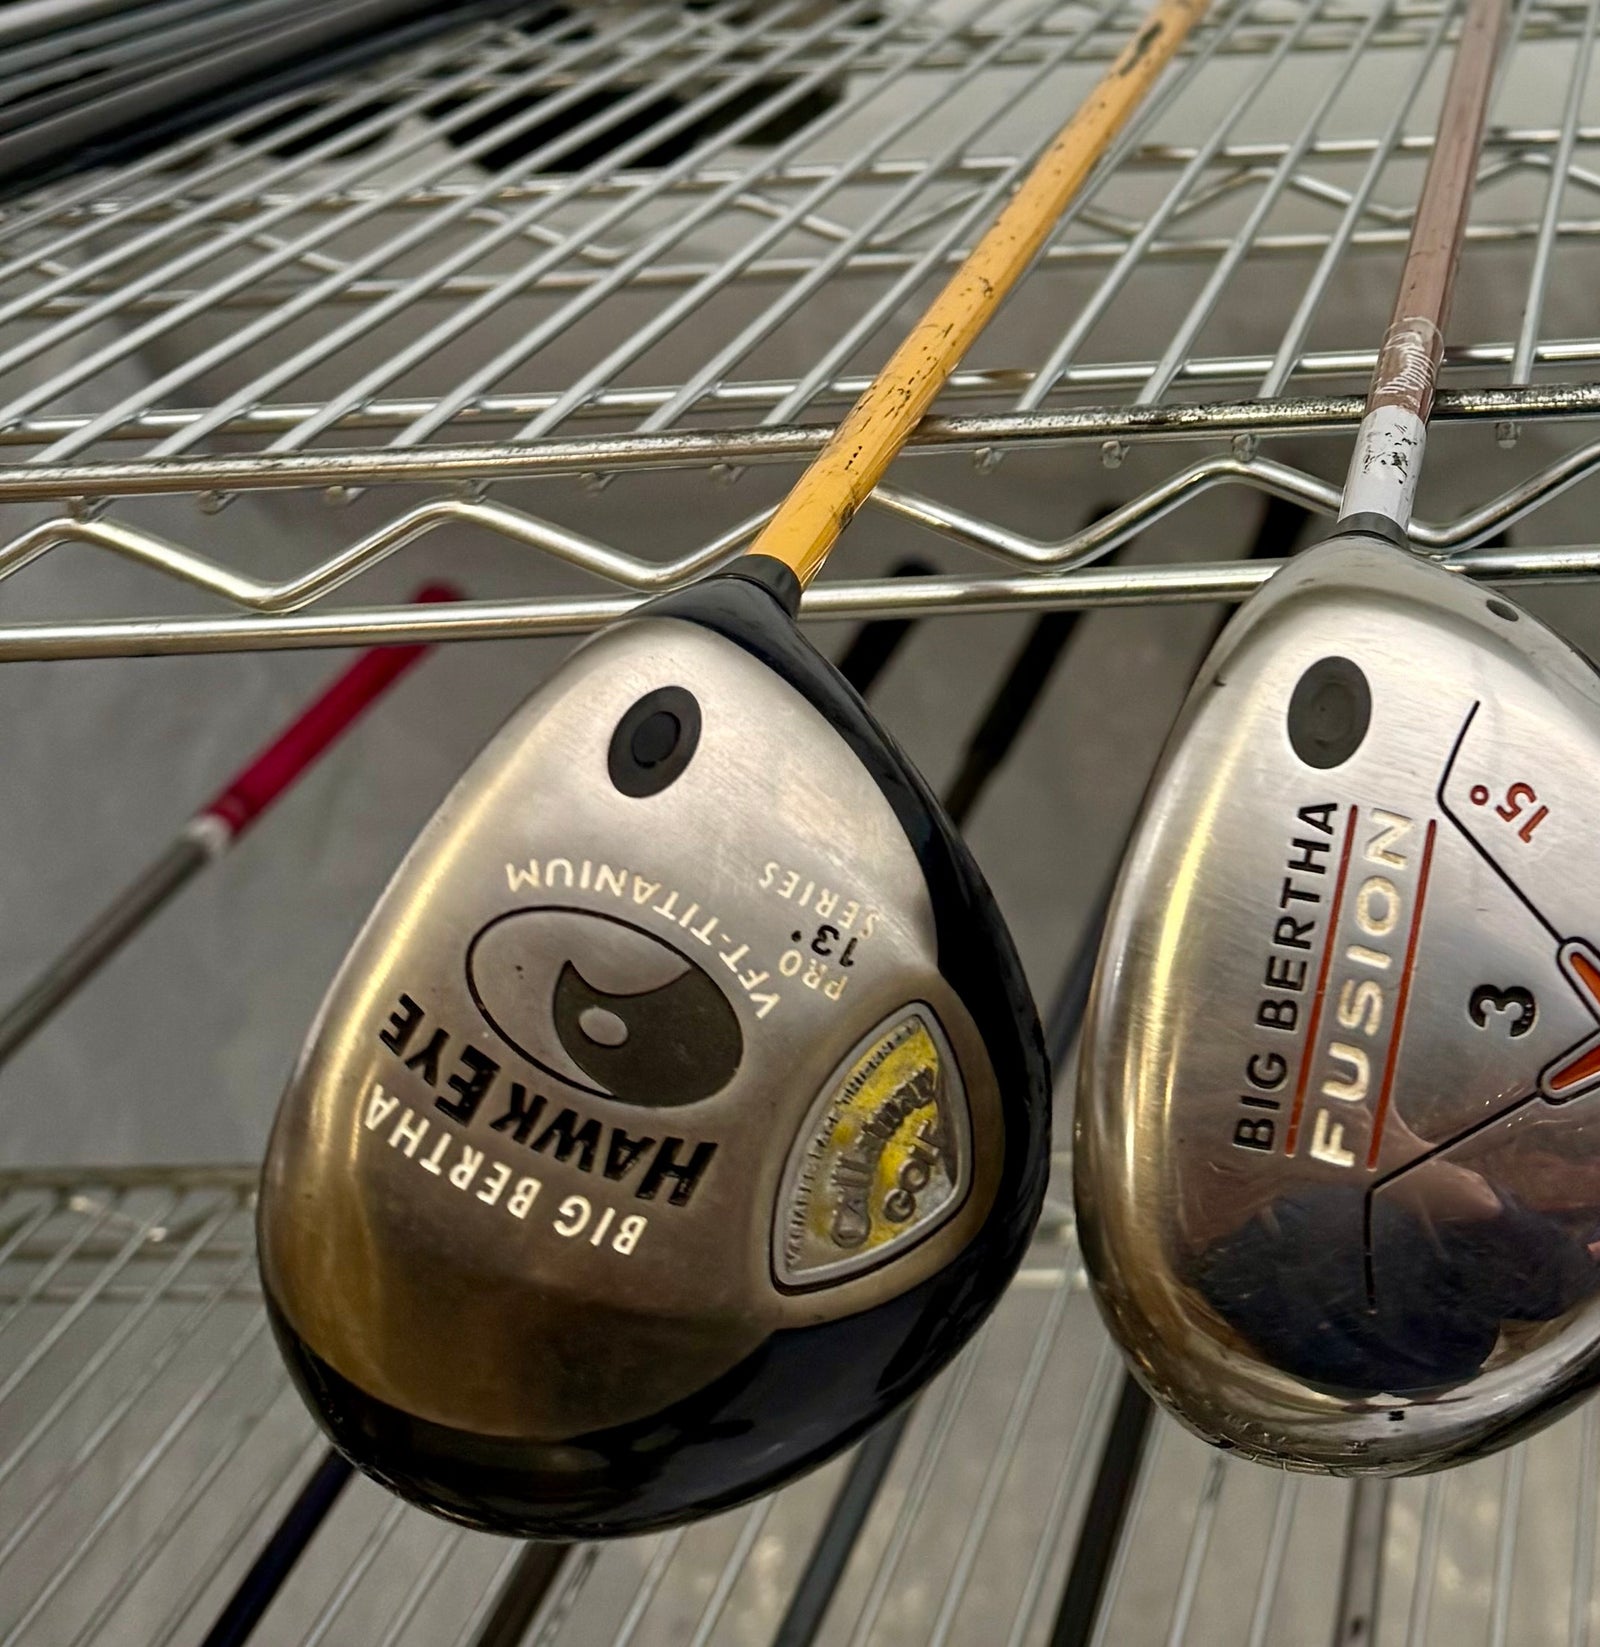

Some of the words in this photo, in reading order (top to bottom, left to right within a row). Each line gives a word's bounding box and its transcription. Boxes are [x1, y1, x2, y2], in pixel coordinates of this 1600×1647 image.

[1469, 781, 1551, 844] 15°
[505, 858, 781, 1020] VFT-TITANIUM
[758, 861, 882, 941] SERIES
[1255, 802, 1339, 1032] BERTHA
[778, 948, 849, 1002] PRO
[1310, 807, 1414, 1168] FUSION
[1468, 983, 1539, 1039] 3
[1233, 1051, 1288, 1153] BIG
[364, 1083, 542, 1220] BERTHA
[553, 1195, 648, 1256] BIG
